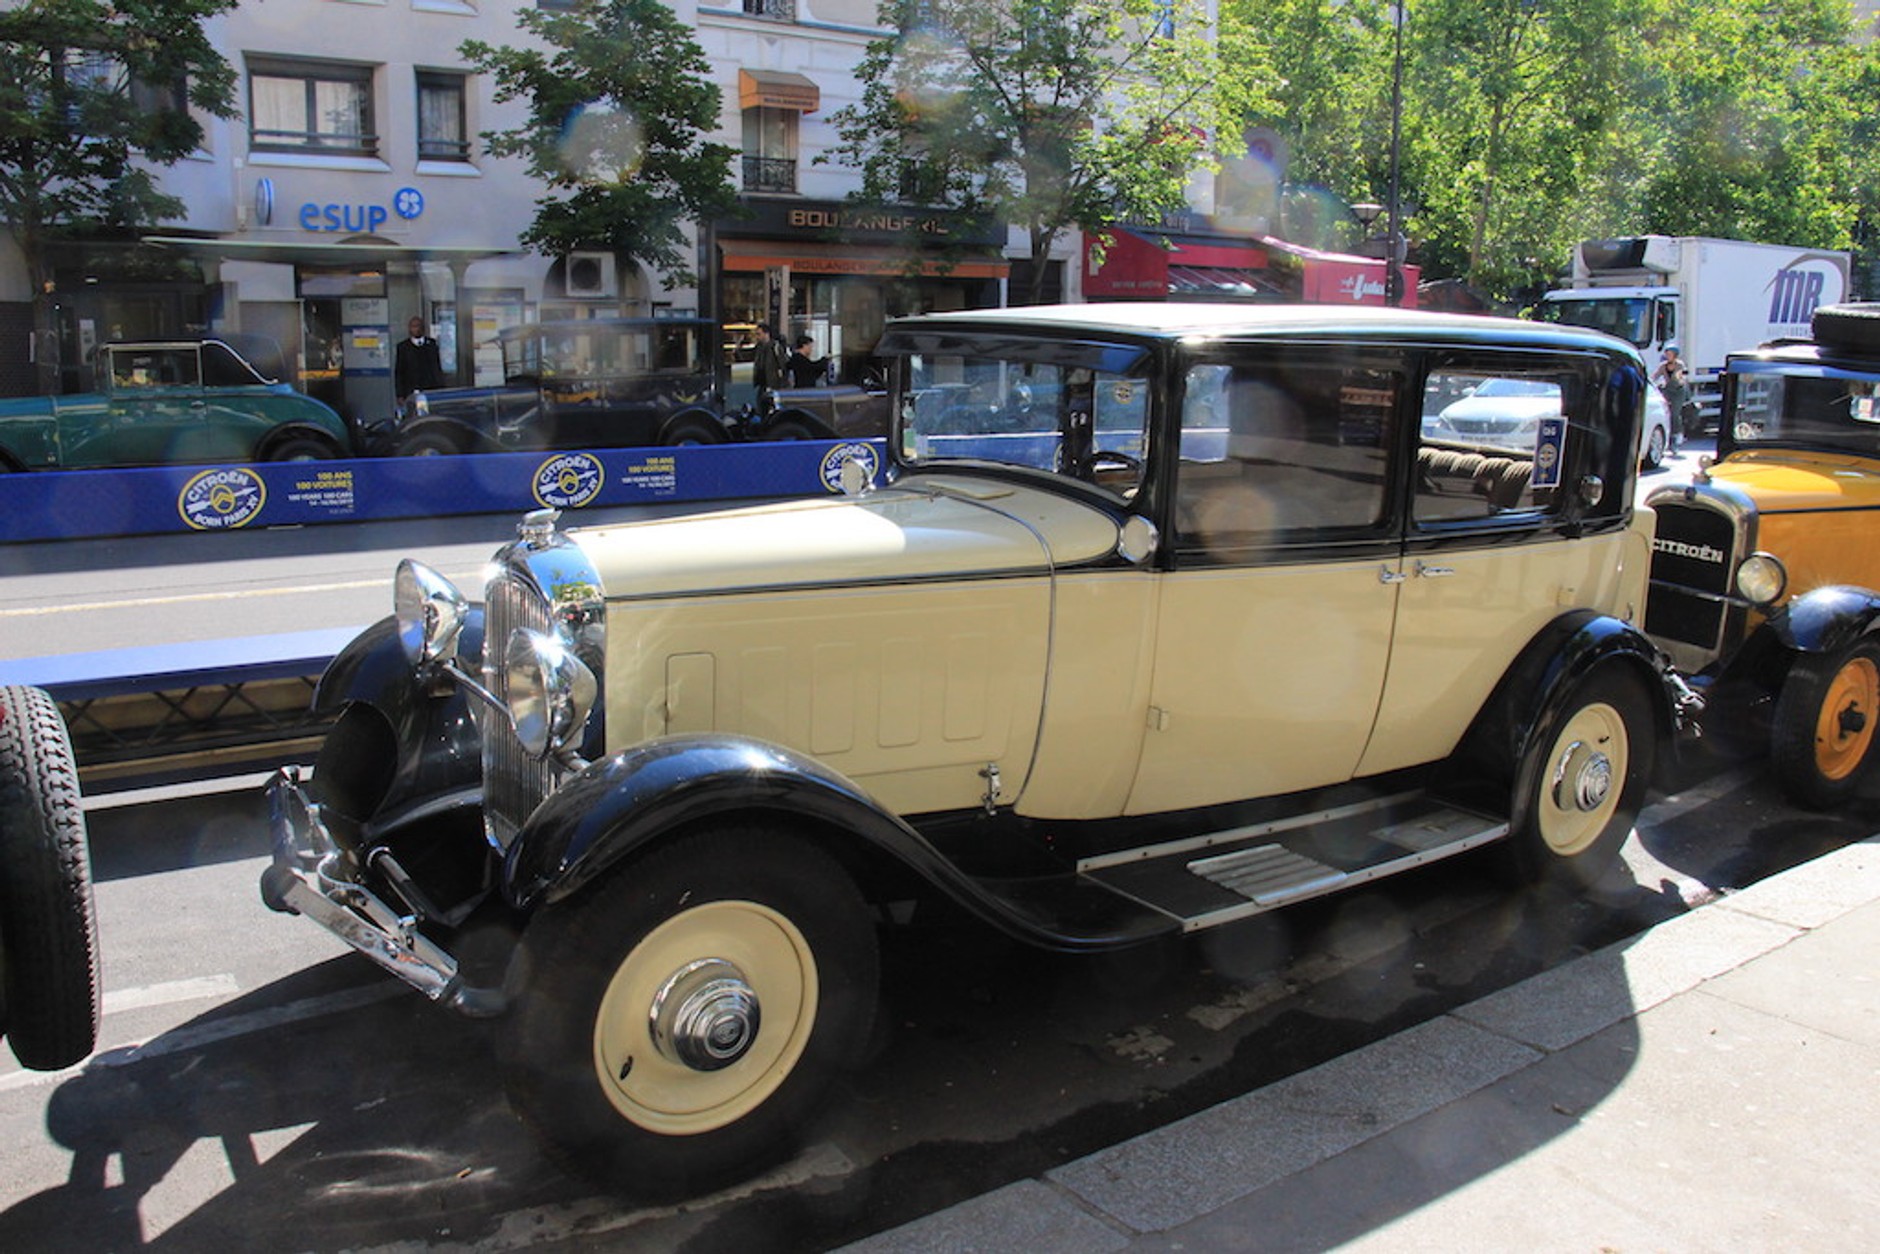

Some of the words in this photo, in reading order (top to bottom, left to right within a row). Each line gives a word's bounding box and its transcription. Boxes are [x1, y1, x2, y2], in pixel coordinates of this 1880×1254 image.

[317, 472, 333, 481] 100
[334, 470, 352, 479] ANS
[540, 455, 591, 484] CITROËN
[187, 471, 249, 502] CITROËN
[544, 494, 568, 506] BORN
[569, 490, 591, 506] PARIS
[194, 513, 221, 527] BORN
[223, 508, 250, 526] PARIS
[1652, 538, 1723, 563] CITROËN
